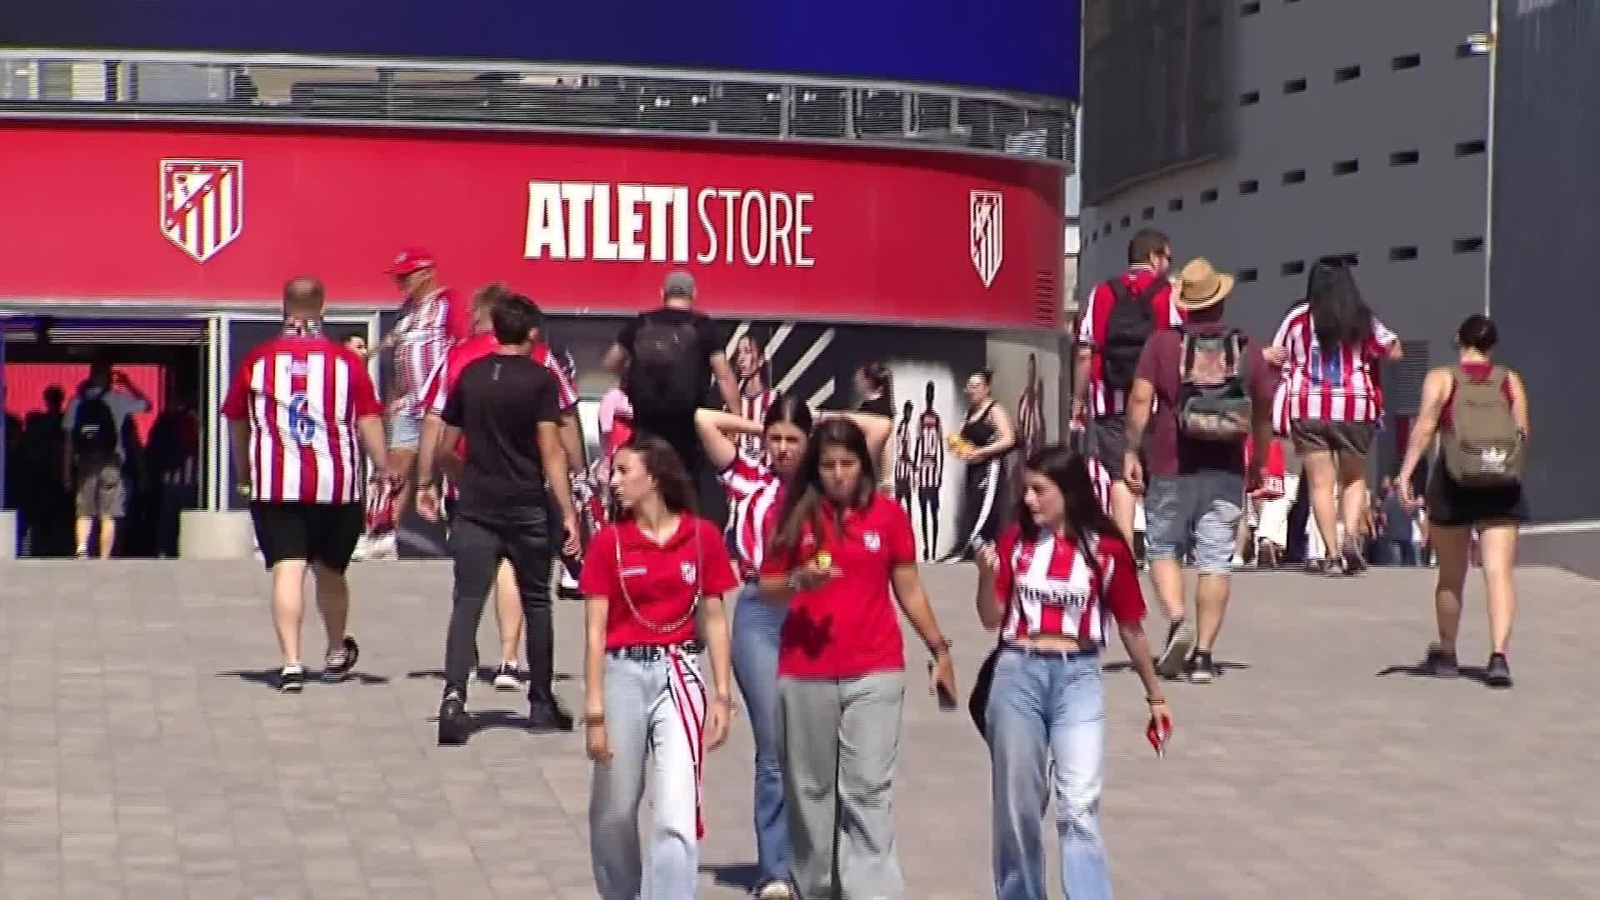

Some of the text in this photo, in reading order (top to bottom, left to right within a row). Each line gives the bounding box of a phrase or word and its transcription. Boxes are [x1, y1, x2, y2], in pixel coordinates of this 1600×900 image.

[524, 180, 815, 267] ATLETI STORE
[289, 394, 316, 443] 6
